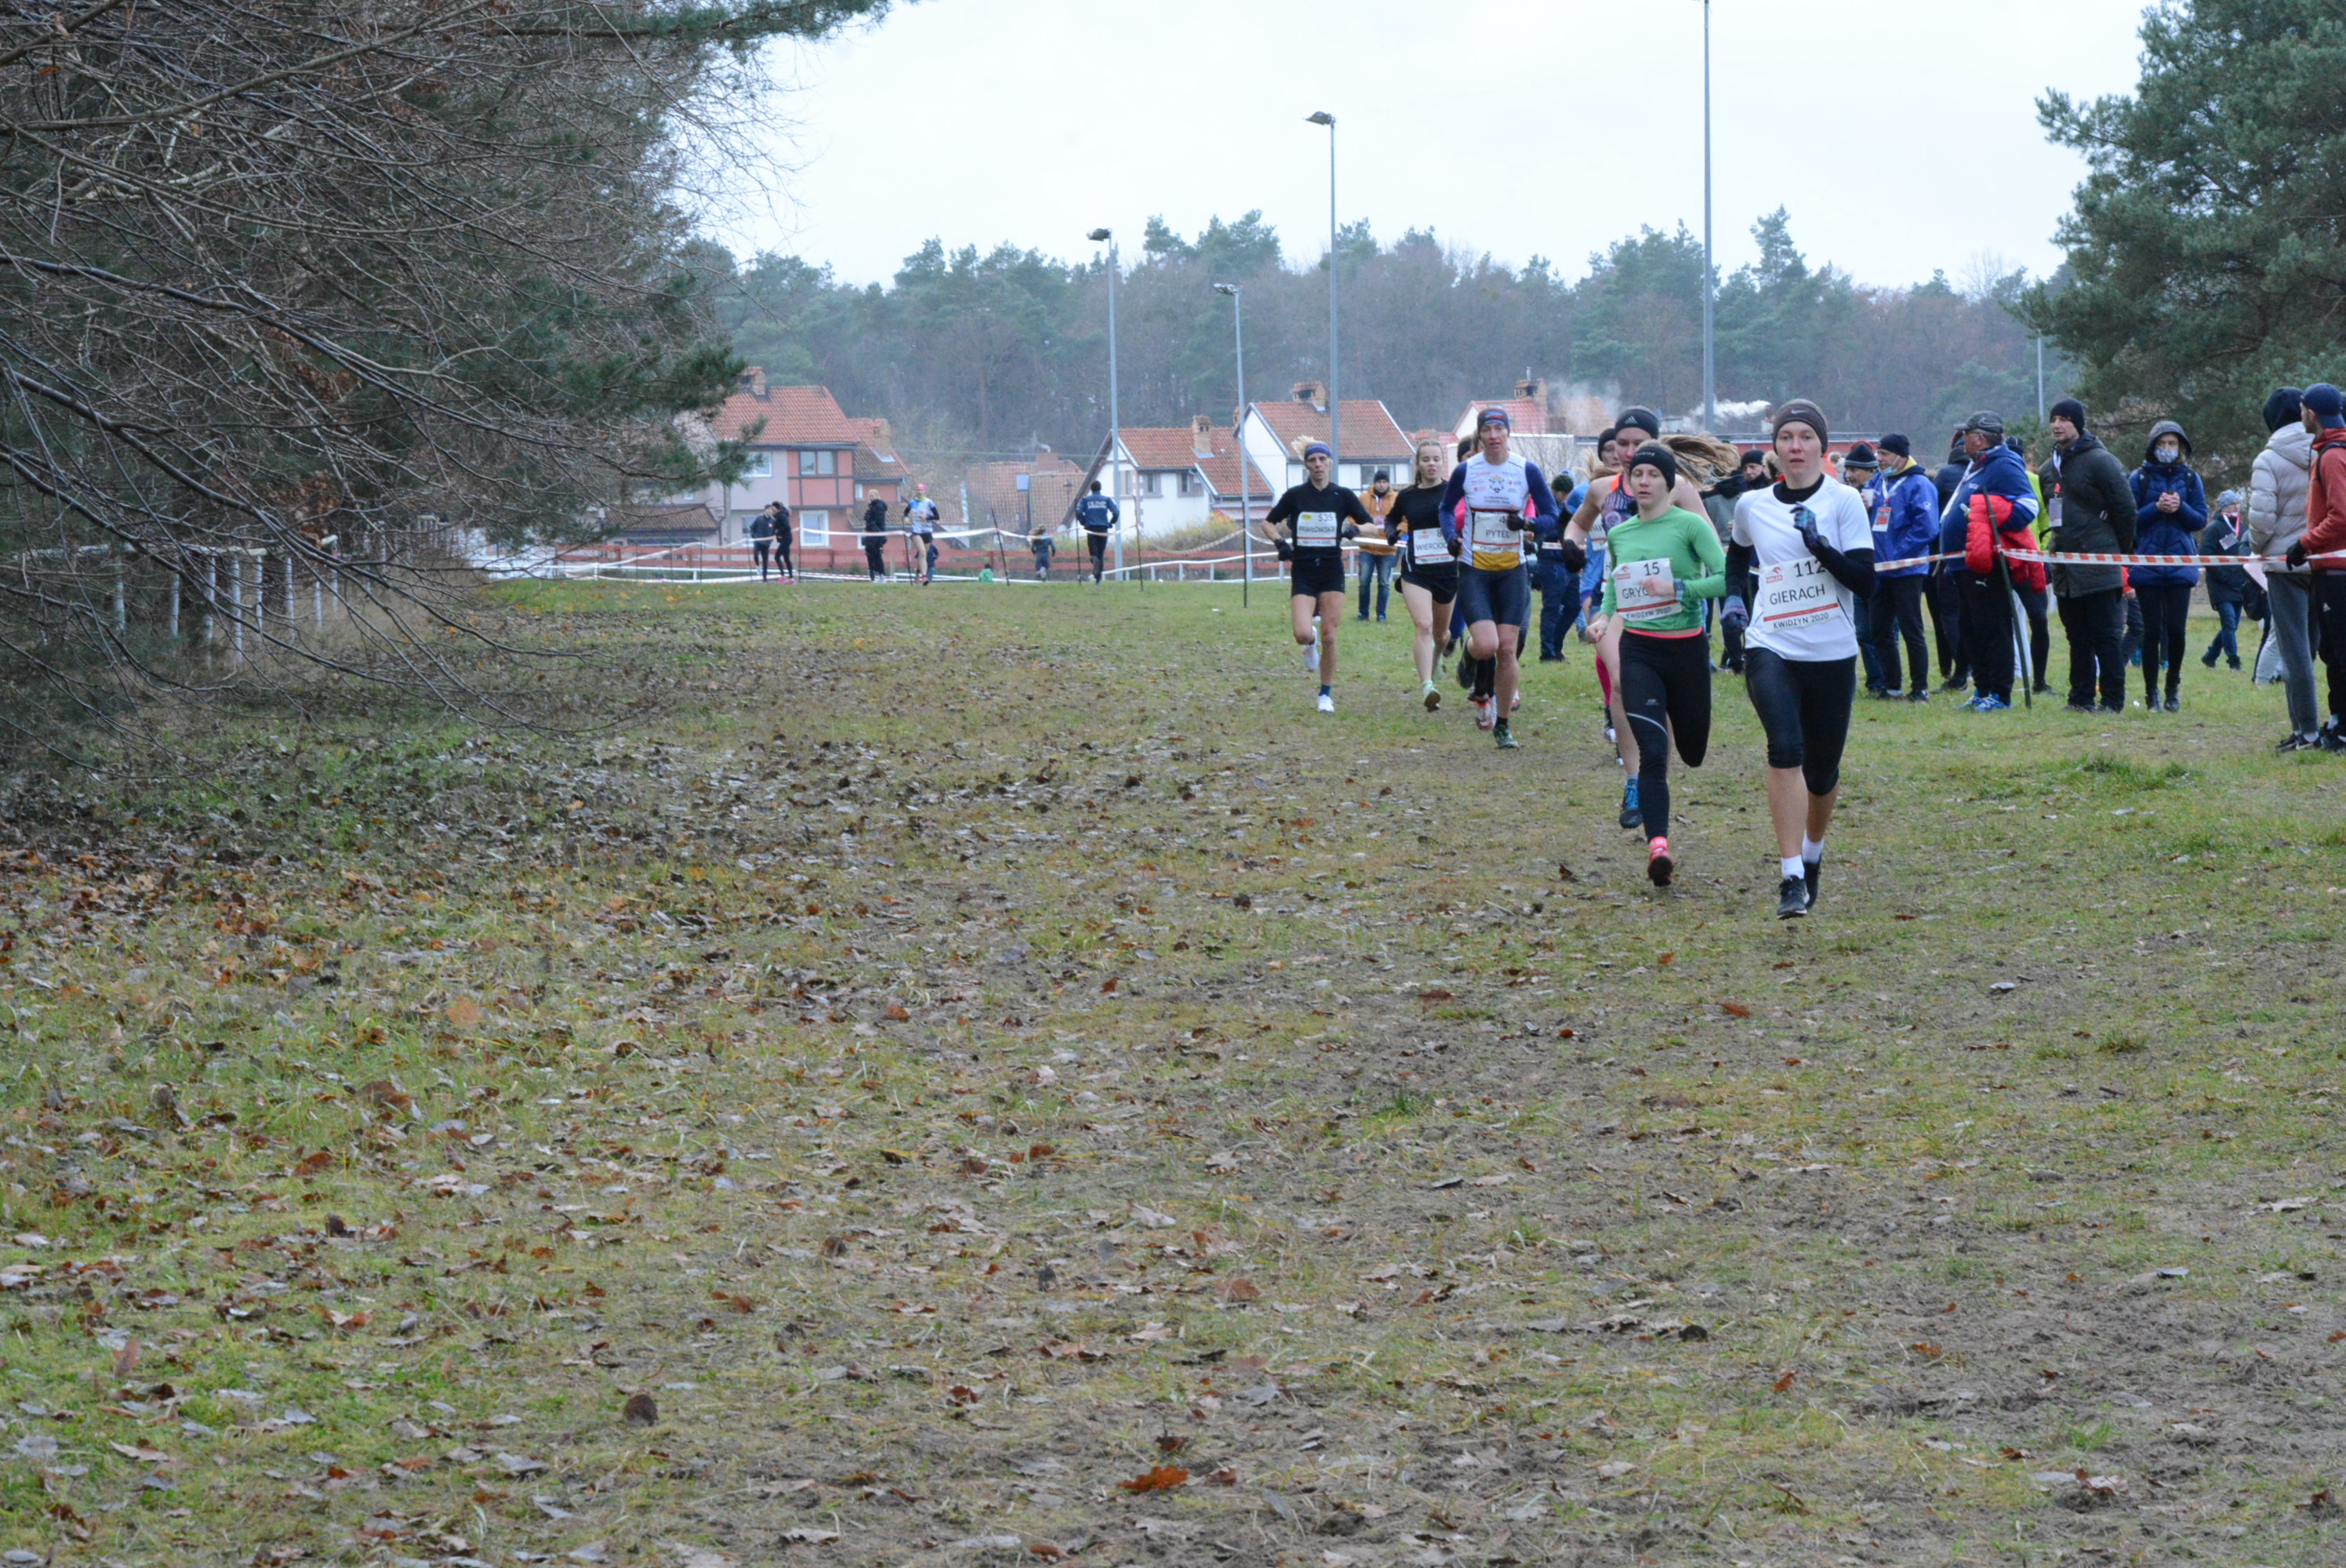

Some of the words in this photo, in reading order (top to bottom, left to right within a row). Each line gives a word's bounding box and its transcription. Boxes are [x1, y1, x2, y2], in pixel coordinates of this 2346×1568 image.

[1643, 561, 1660, 576] 15
[1793, 560, 1826, 578] 112
[1769, 583, 1825, 605] GIERACH
[1654, 607, 1672, 615] 2020
[1773, 617, 1809, 630] KWIDZYN
[1810, 612, 1829, 623] 2020
